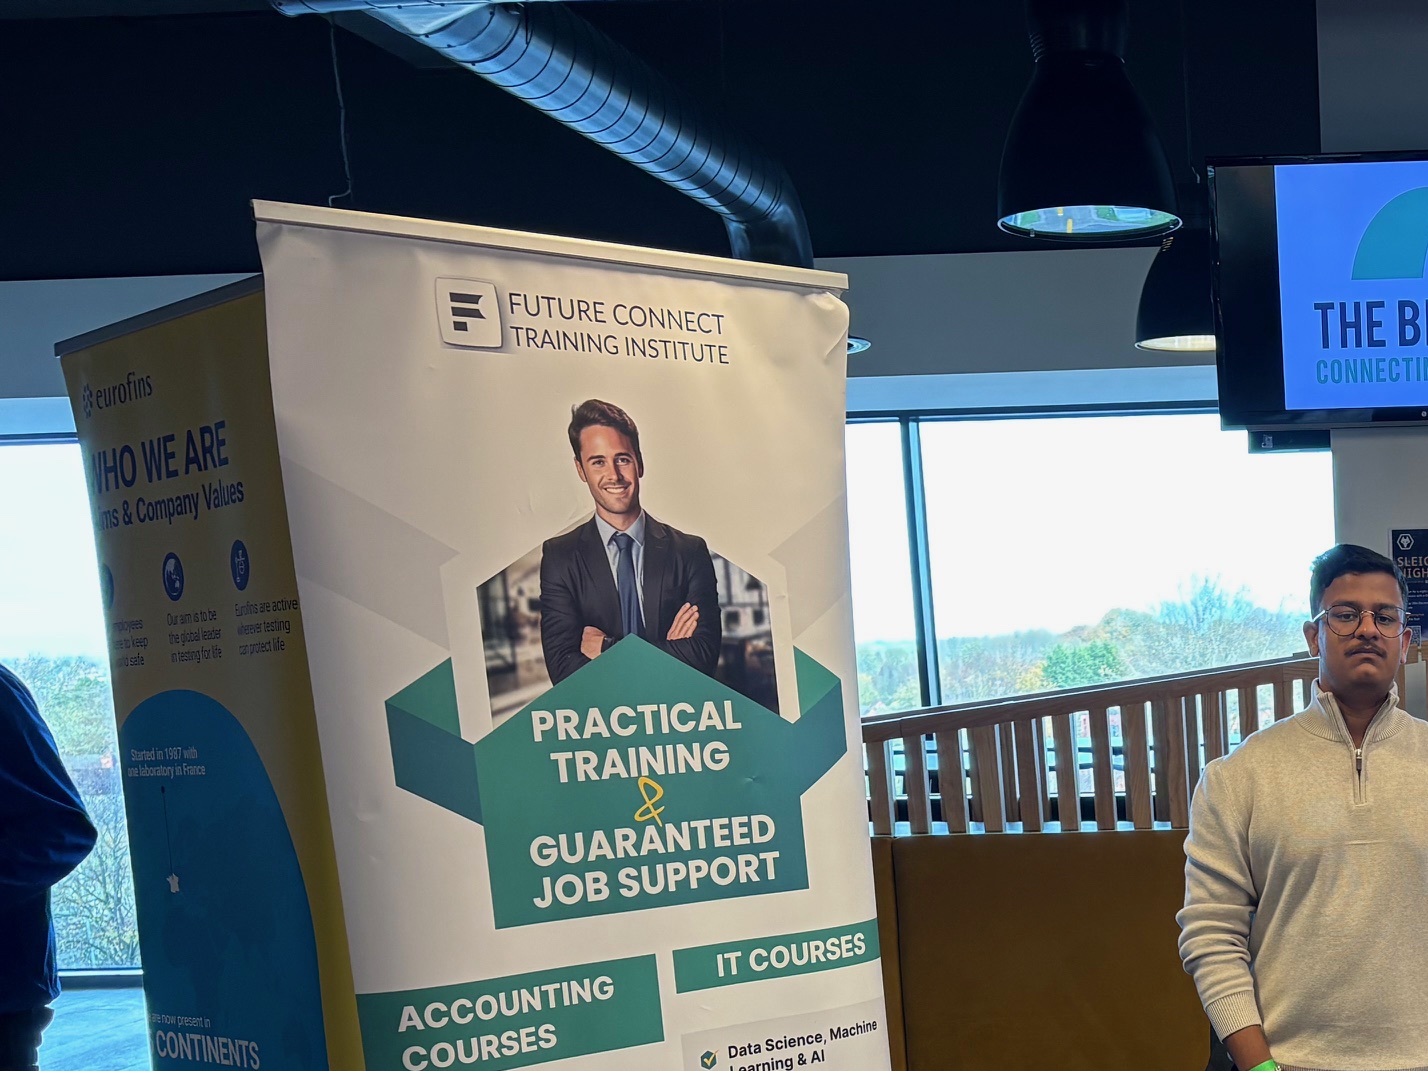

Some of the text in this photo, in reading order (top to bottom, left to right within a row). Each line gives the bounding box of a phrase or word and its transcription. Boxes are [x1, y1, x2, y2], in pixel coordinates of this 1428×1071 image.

[509, 293, 724, 334] FUTURE CONNECT
[1314, 301, 1386, 348] THE
[510, 326, 729, 364] TRAINING INSTITUTE
[96, 372, 152, 409] eurofins
[141, 434, 178, 482] WE
[185, 421, 228, 474] ARE
[122, 480, 244, 525] & Company Values
[532, 700, 742, 741] PRACTICAL
[550, 742, 729, 782] TRAINING
[632, 773, 664, 830] &
[530, 815, 775, 866] GUARANTEED
[534, 851, 779, 908] JOB SUPPORT
[717, 933, 865, 976] IT COURSES
[397, 976, 614, 1033] ACCOUNTING
[156, 1030, 259, 1069] CONTINENTS
[401, 1024, 557, 1071] COURSES
[728, 1021, 877, 1058] Data Science, Machine
[798, 1053, 806, 1065] &
[811, 1050, 824, 1063] AI
